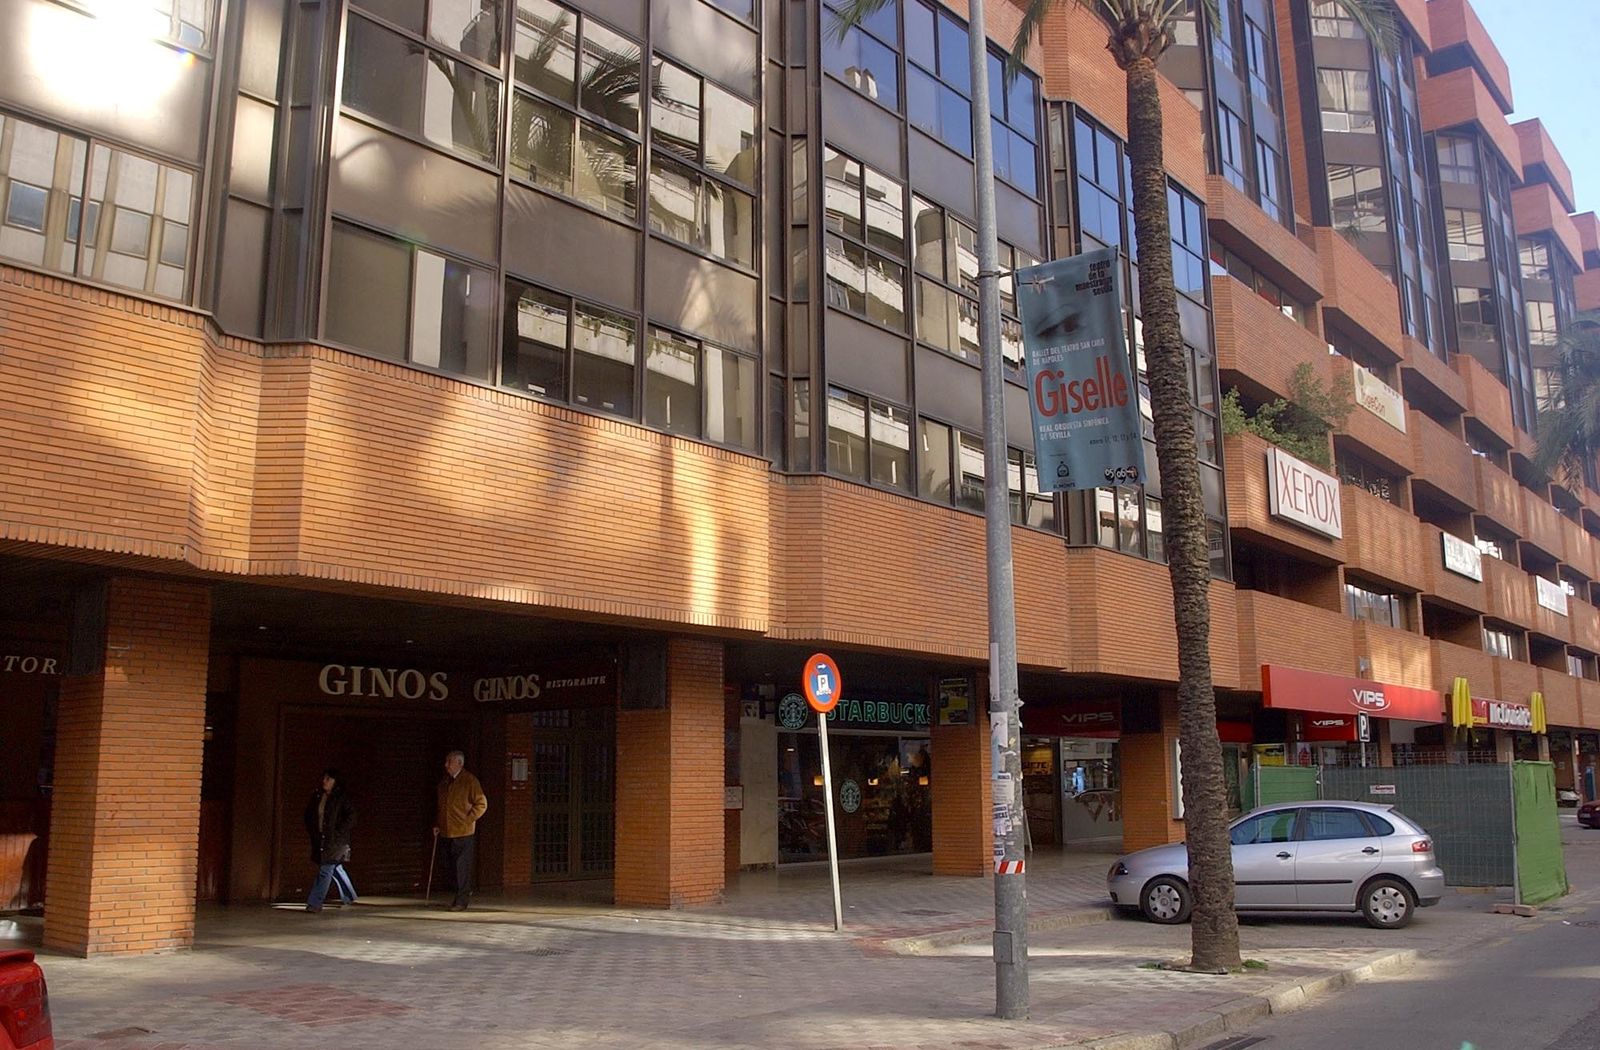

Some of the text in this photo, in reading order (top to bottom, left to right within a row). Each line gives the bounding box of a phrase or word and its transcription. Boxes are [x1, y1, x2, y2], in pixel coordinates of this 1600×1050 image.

[1050, 346, 1061, 355] DEL
[1080, 341, 1091, 350] SAN
[1035, 355, 1129, 417] Giselle
[1048, 431, 1072, 440] SEVILLA
[1279, 460, 1340, 529] XEROX
[4, 655, 63, 676] TOR
[318, 663, 449, 702] GINOS
[473, 672, 607, 703] GINOS RISTORANTE
[1352, 688, 1385, 708] VIPS
[1061, 711, 1115, 723] VIPS
[1312, 719, 1345, 727] VIPS
